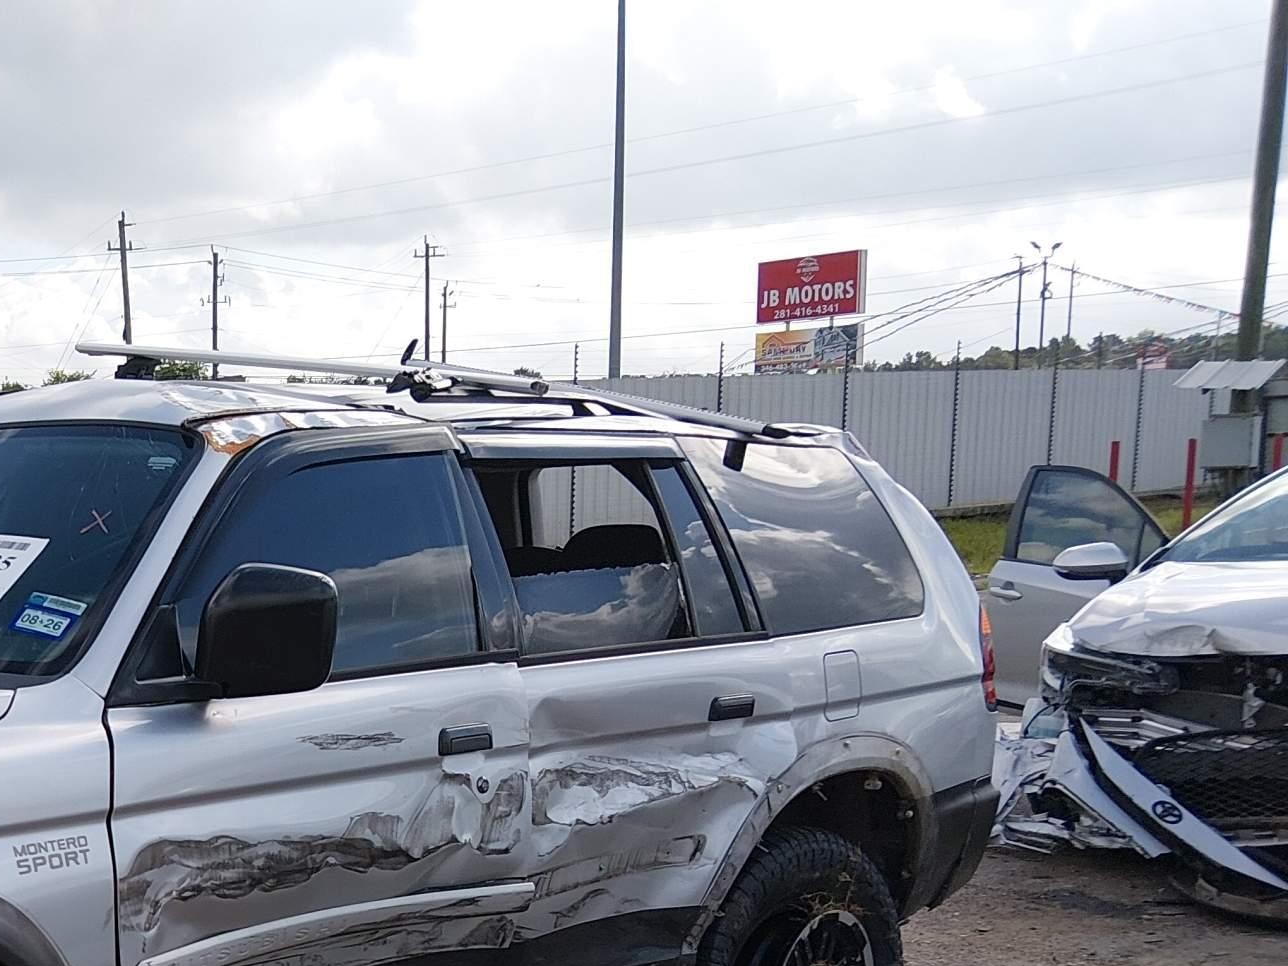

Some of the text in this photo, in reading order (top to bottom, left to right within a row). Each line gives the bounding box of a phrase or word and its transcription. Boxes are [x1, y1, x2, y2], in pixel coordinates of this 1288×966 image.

[761, 280, 855, 308] JB MOTORS
[773, 303, 839, 319] 281-416-4341
[43, 618, 64, 631] 26
[12, 835, 88, 857] MONTERO
[16, 848, 91, 875] SPORT
